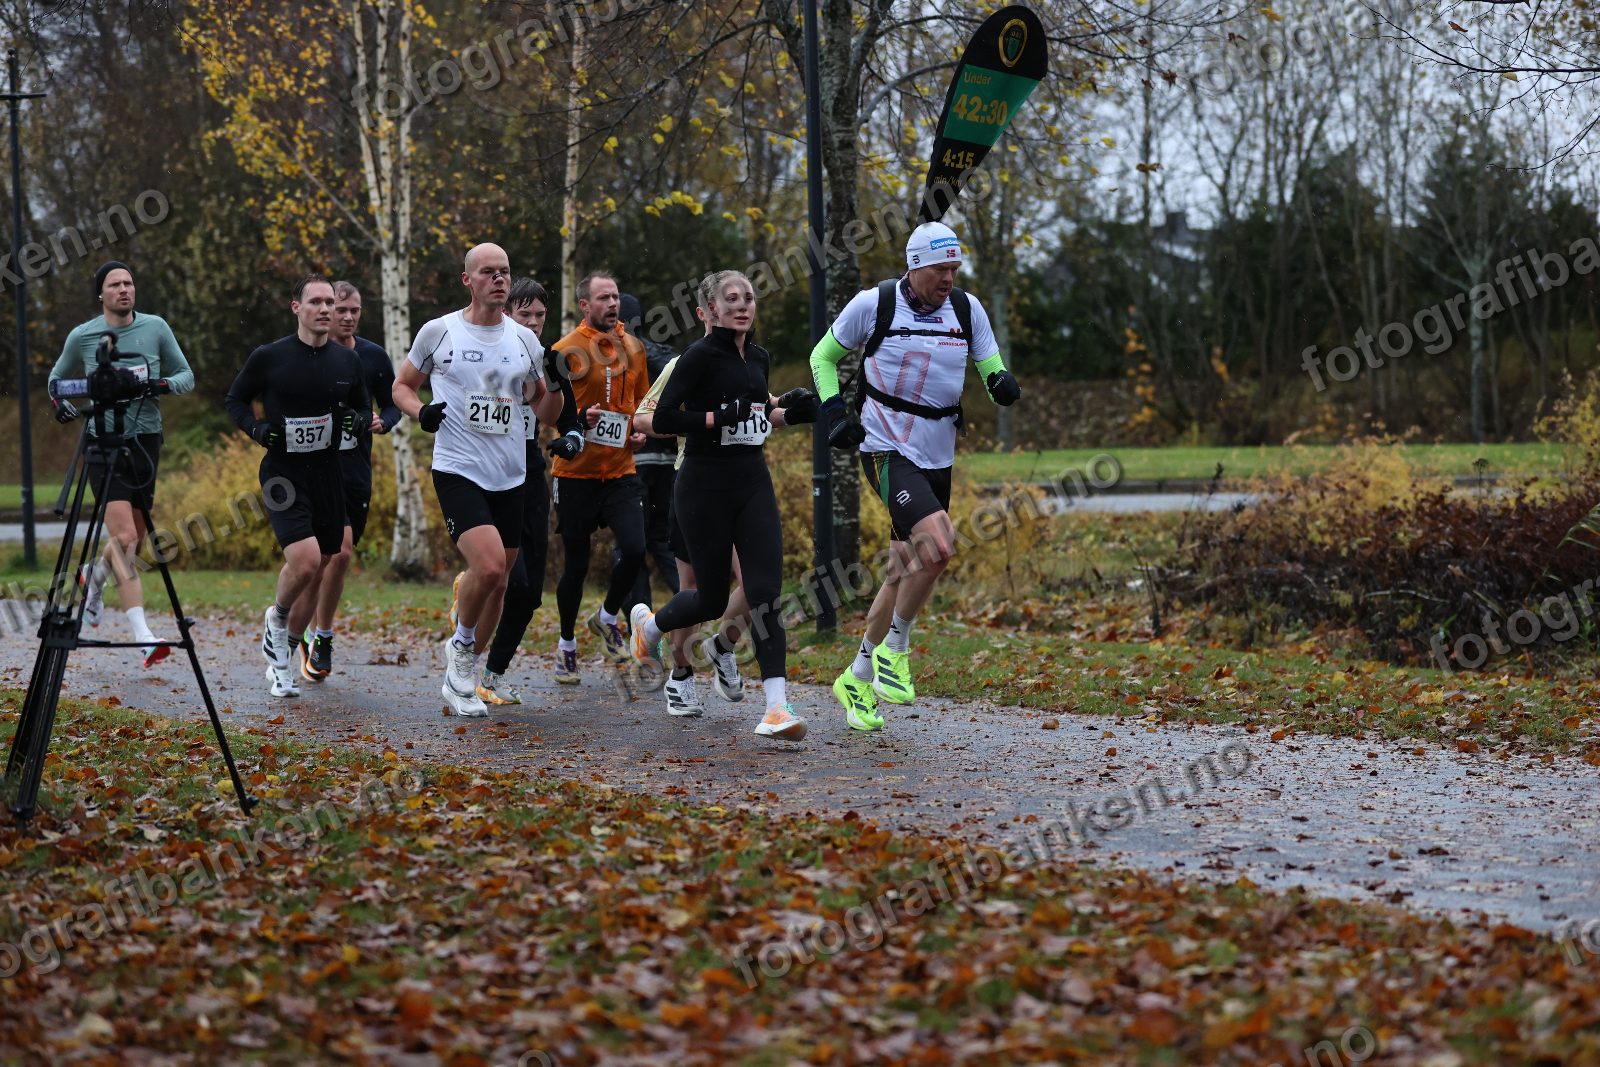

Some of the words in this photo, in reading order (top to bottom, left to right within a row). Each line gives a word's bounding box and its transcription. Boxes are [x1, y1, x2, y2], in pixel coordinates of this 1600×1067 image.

[964, 71, 992, 85] Under
[953, 93, 1008, 127] 42:30
[942, 148, 975, 169] 4:15
[469, 402, 511, 425] 2140
[295, 425, 325, 445] 357
[596, 420, 622, 440] 640
